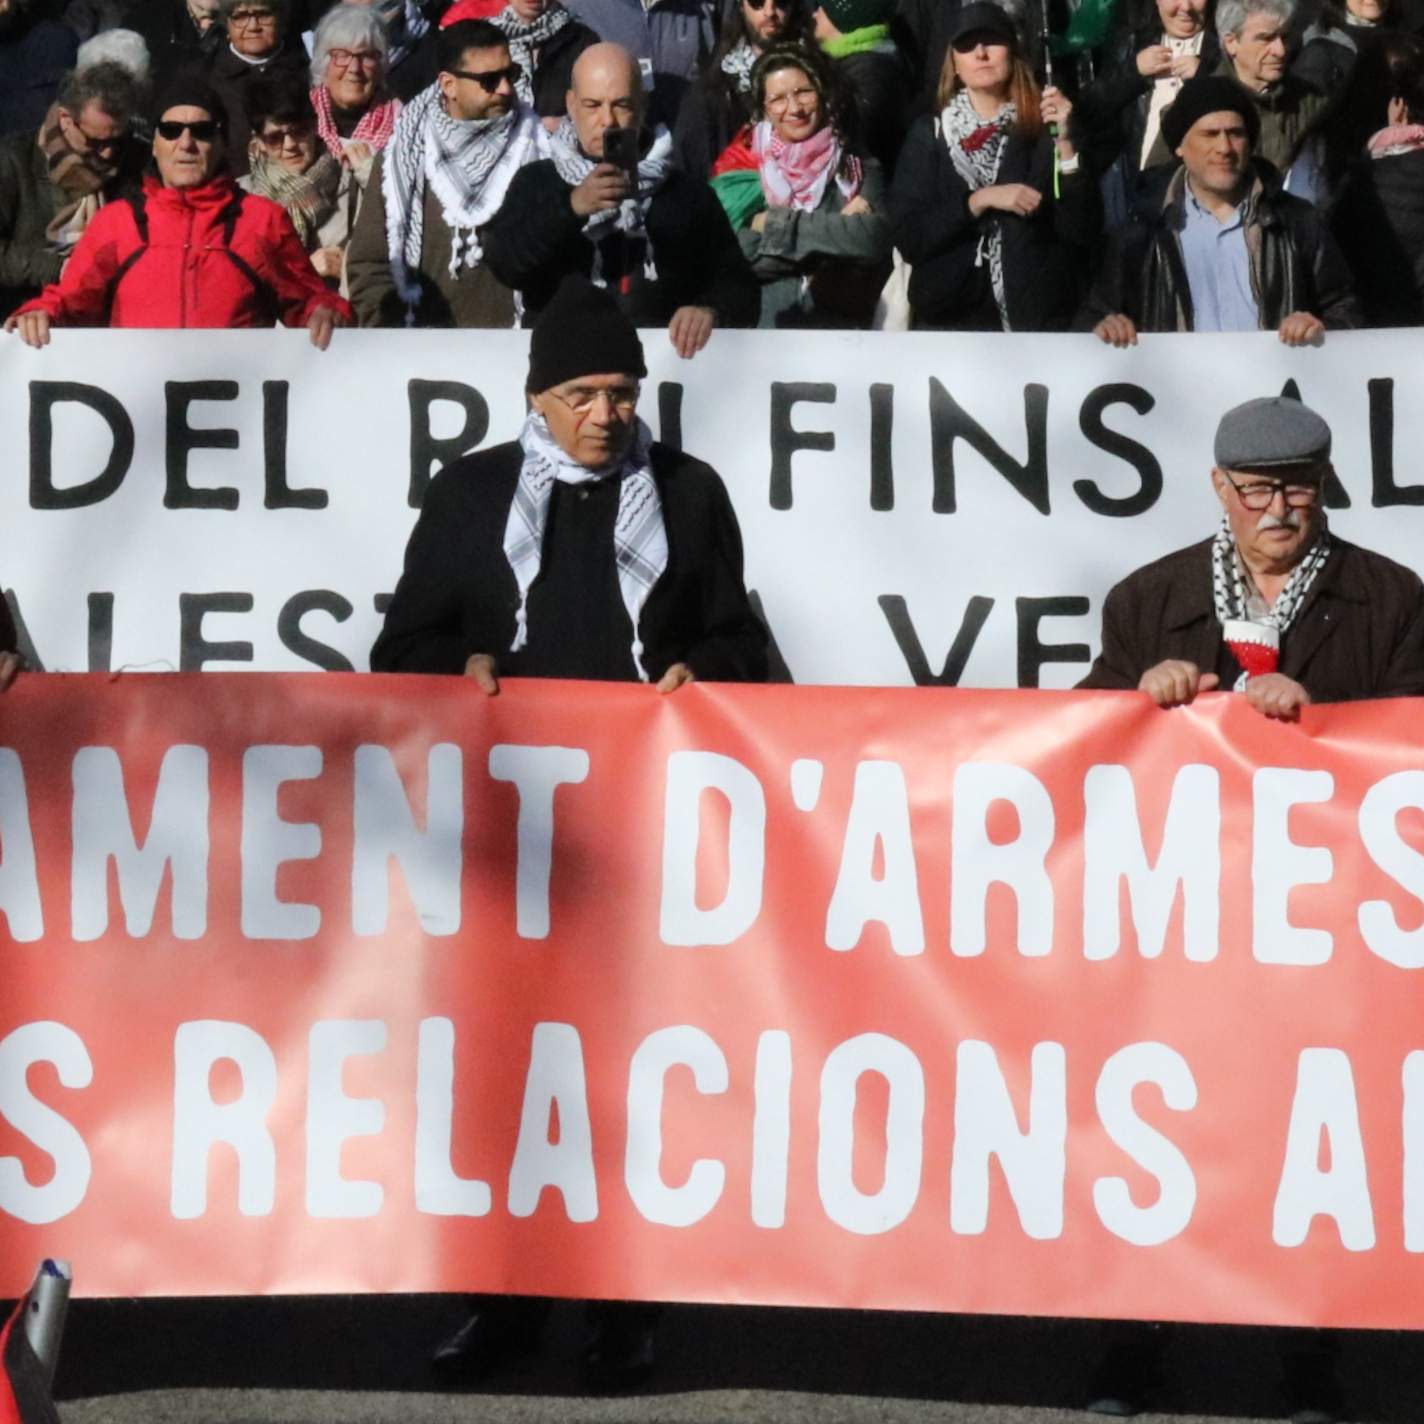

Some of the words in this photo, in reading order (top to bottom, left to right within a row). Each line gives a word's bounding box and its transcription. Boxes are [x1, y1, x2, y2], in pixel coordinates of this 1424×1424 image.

[28, 380, 327, 510] DEL
[768, 375, 1164, 518] FINS
[169, 1016, 1198, 1247] RELACIONS
